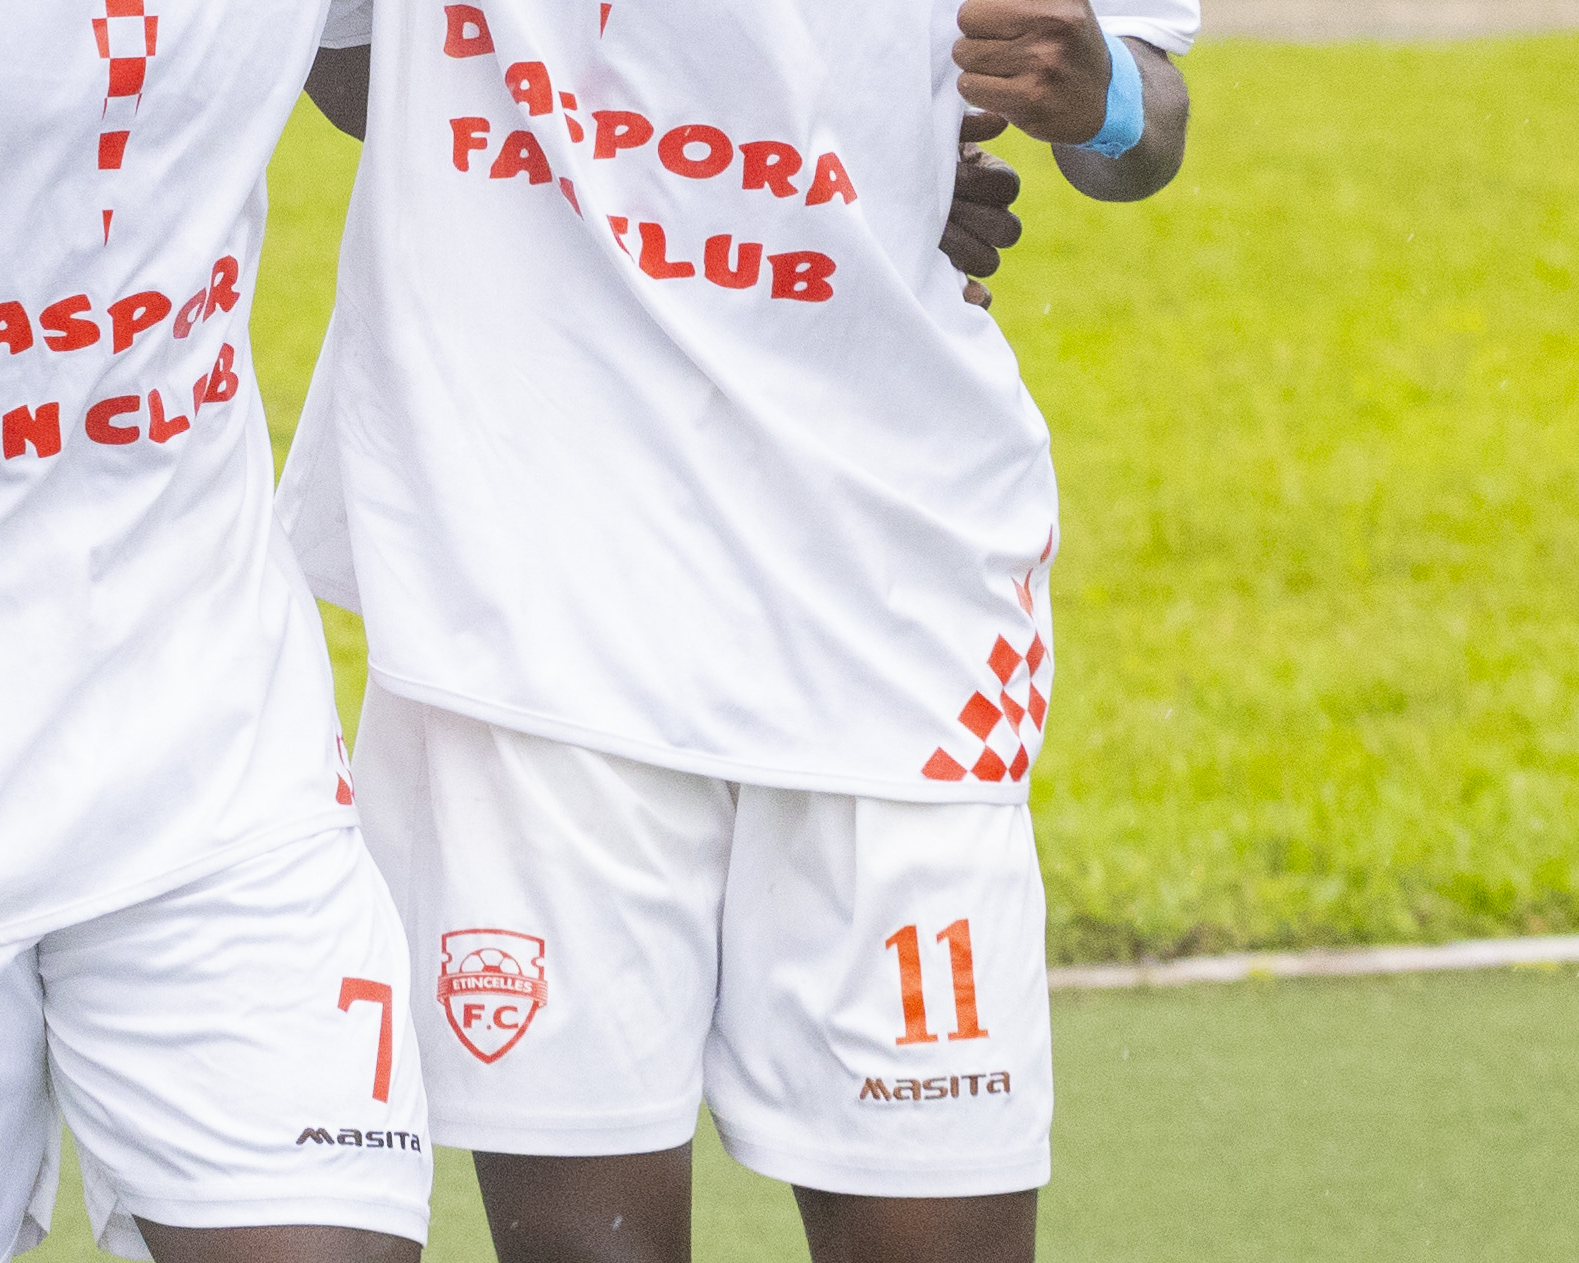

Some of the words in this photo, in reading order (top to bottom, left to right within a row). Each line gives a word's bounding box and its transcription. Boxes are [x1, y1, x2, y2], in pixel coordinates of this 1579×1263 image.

[452, 976, 533, 993] ETINCELLES
[462, 1003, 519, 1030] F.C
[884, 917, 989, 1046] 11
[337, 976, 393, 1103] 7
